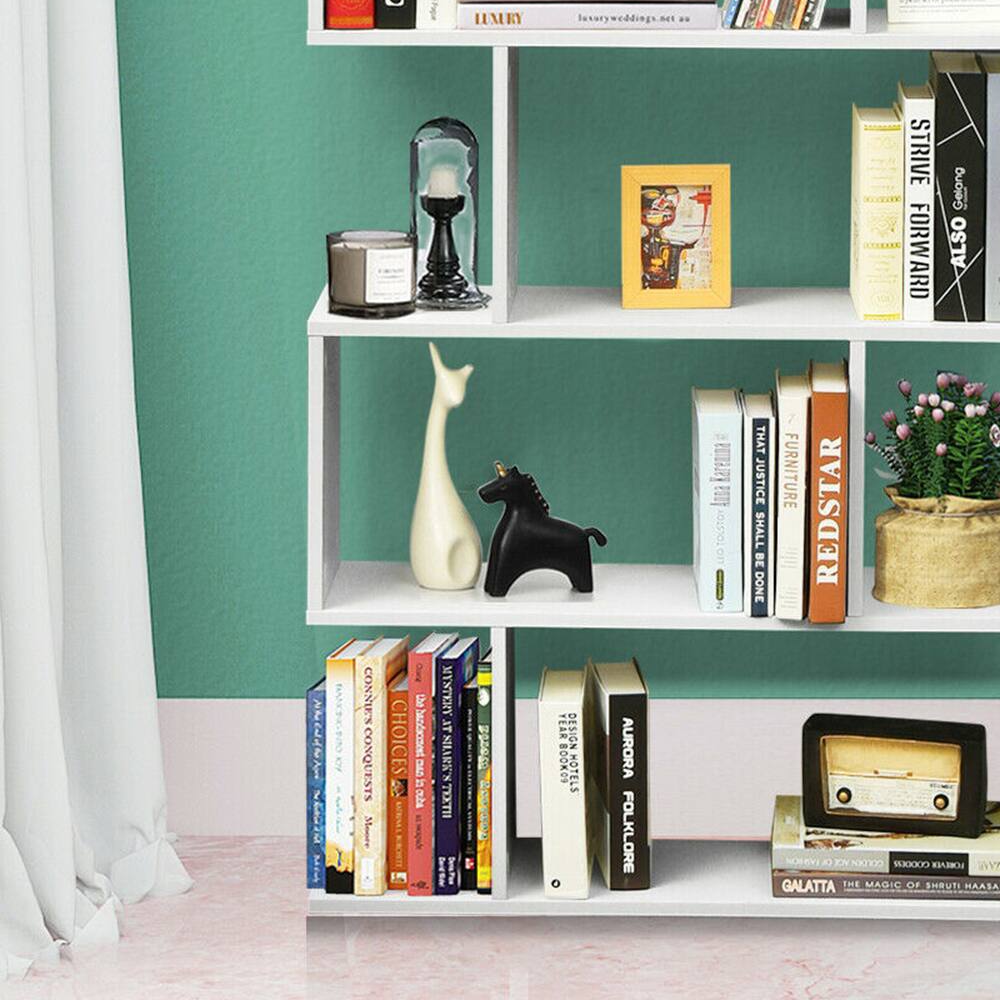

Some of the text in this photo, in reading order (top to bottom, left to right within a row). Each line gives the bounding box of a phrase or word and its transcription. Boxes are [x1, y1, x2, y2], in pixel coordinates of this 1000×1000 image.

[475, 13, 523, 24] LUXURY
[910, 120, 930, 298] STRIVE FORWARD
[953, 167, 967, 210] Gelang
[950, 217, 966, 268] ALSO
[784, 433, 798, 508] FURNITURE
[754, 426, 765, 603] THAT JUSTICE SHALL BE DONE
[817, 437, 841, 584] REDSTAR
[443, 666, 452, 716] MYSTERY
[391, 699, 408, 774] CHOICES
[443, 719, 452, 733] AT
[558, 714, 567, 740] YEAR
[363, 667, 372, 850] CONNIE'S CONQUESTS Moore
[568, 713, 579, 793] DESIGN HOTELS
[442, 784, 452, 818] TEETH
[623, 718, 634, 873] AURORA FOLKLORE
[782, 880, 835, 893] GALATTA
[844, 881, 860, 889] THE
[865, 881, 901, 890] MAGIC
[906, 882, 922, 890] OF
[926, 882, 961, 890] SHRUTI
[786, 858, 885, 869] GOLDEN AGE OF FASHION
[894, 860, 964, 870] FOREVER GODDESS
